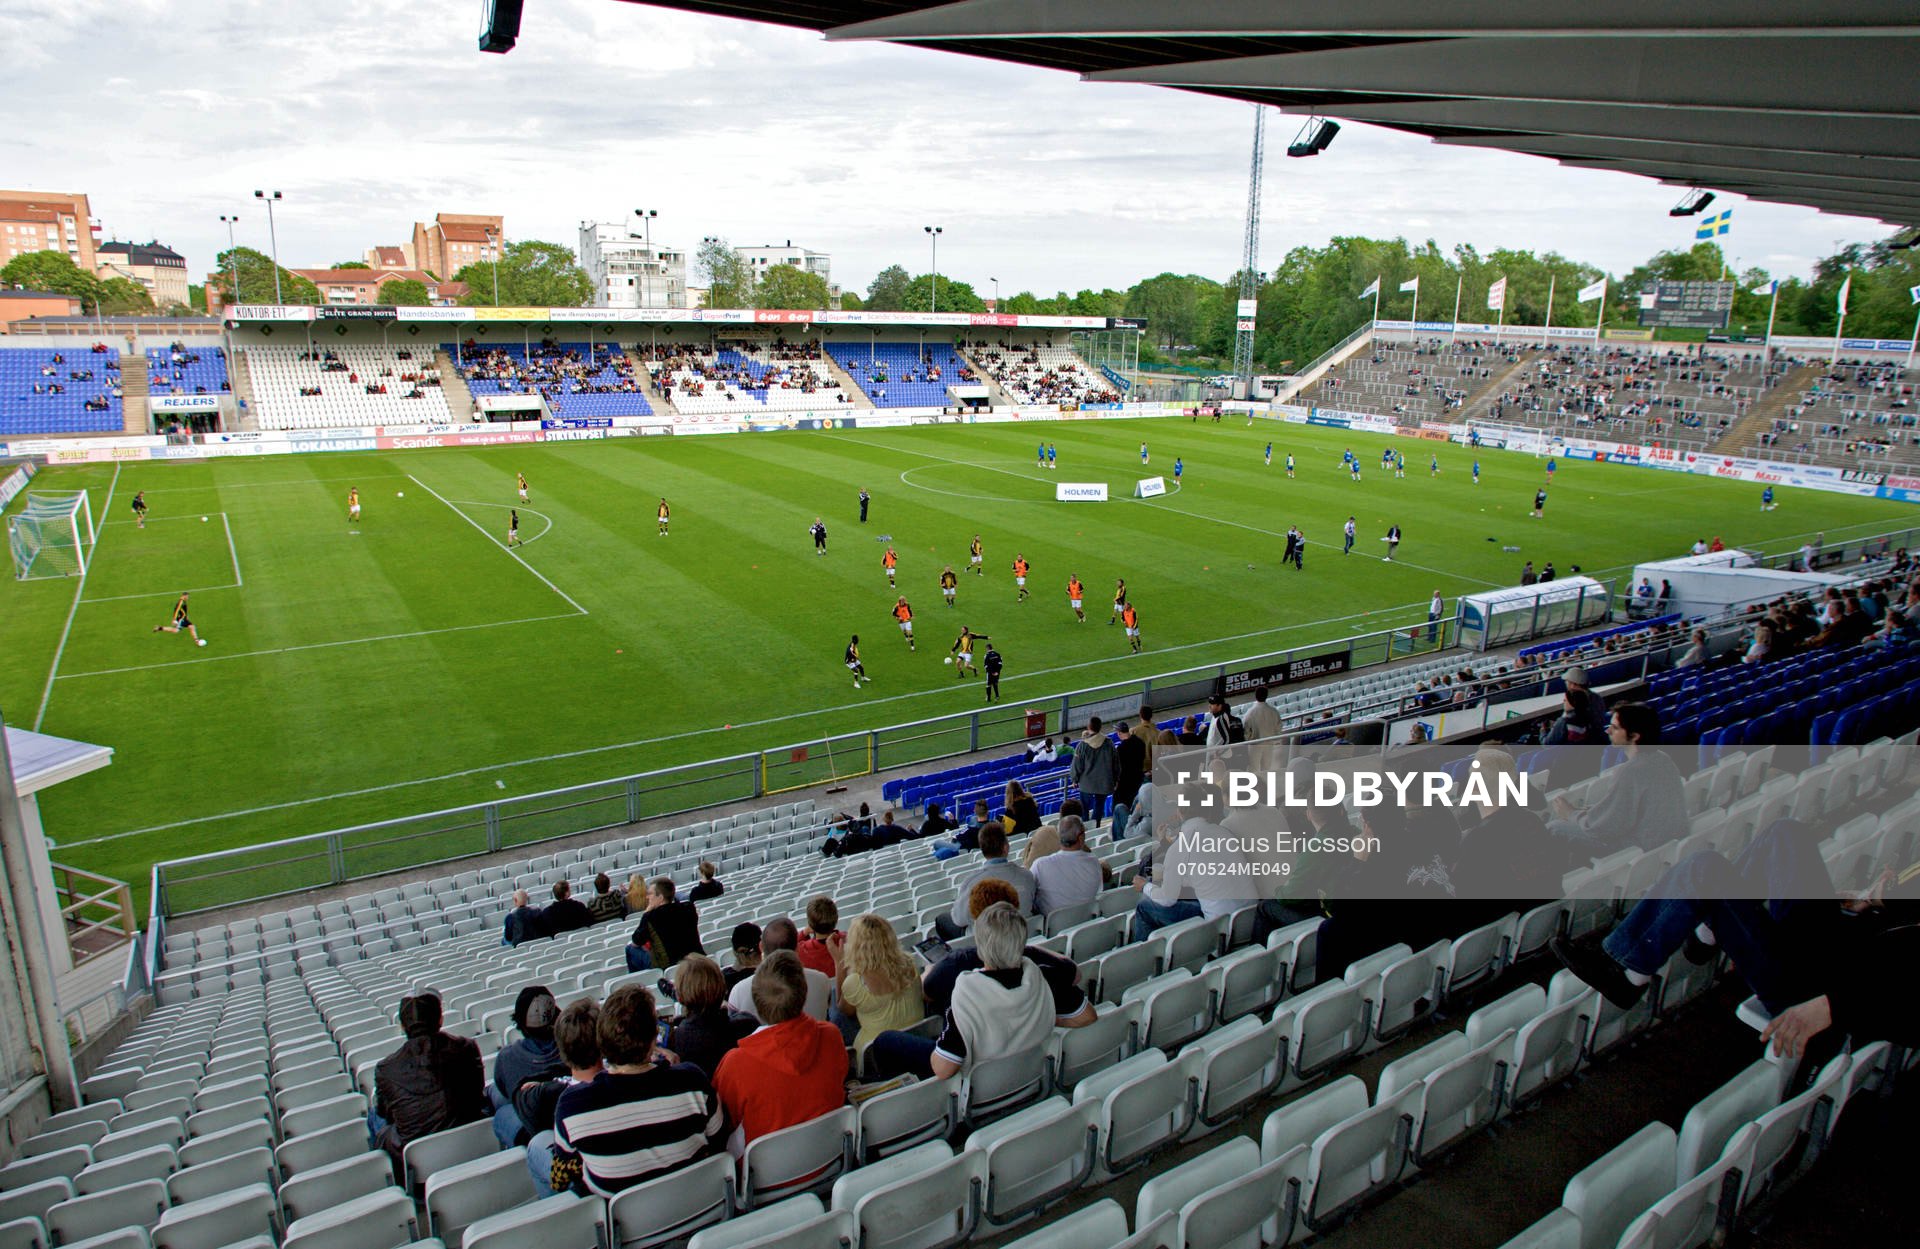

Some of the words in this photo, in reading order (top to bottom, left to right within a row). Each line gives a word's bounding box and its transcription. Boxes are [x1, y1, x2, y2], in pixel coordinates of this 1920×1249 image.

[400, 309, 466, 318] Handelsbanken
[164, 397, 216, 406] REJLERS
[545, 429, 604, 441] STRYKTIPSET
[292, 438, 376, 453] LOKALDELEN
[393, 436, 443, 449] Scandic
[1616, 444, 1640, 457] ABB
[1648, 448, 1674, 460] ABB
[1289, 664, 1327, 679] DEMOL
[1329, 660, 1343, 671] AB
[1225, 678, 1266, 692] DEMOL
[1268, 673, 1283, 684] AB
